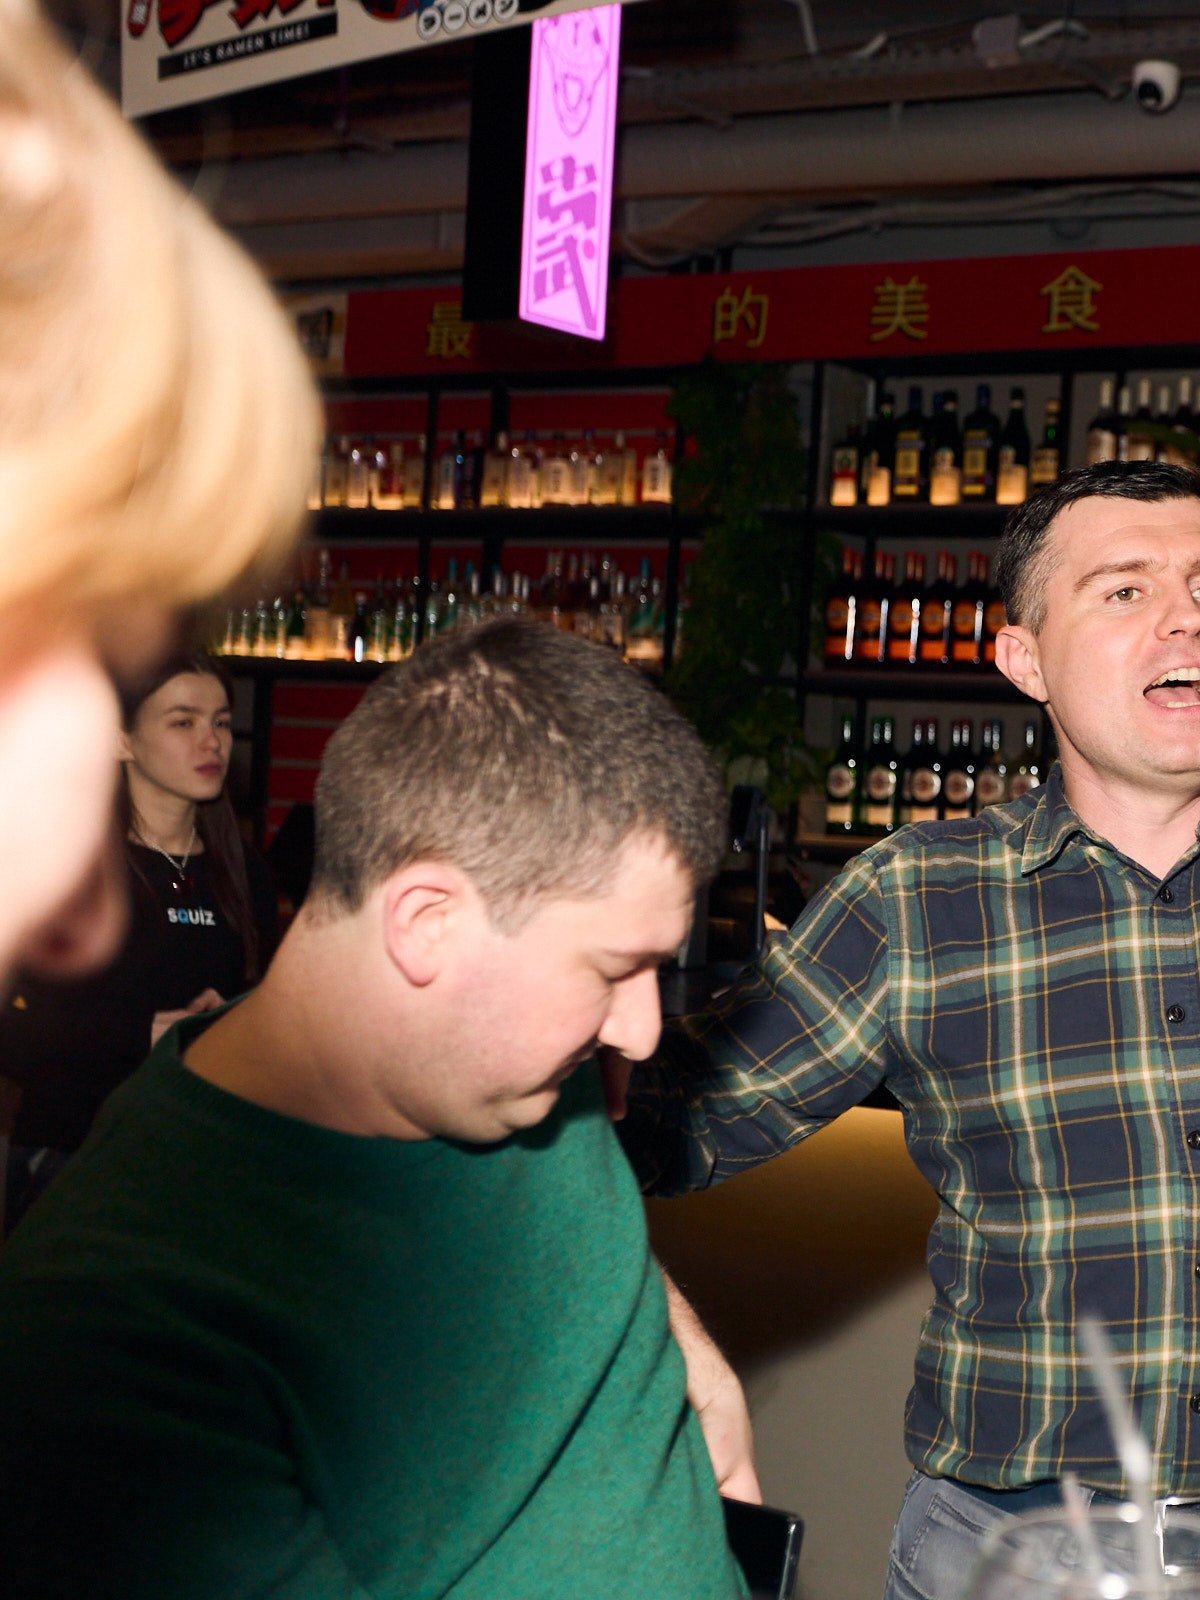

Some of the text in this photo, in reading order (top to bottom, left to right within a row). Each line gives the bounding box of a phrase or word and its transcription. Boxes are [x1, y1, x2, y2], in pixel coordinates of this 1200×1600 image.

[184, 50, 212, 68] IT'S
[216, 36, 265, 60] RAMEN
[270, 22, 310, 46] TIME!
